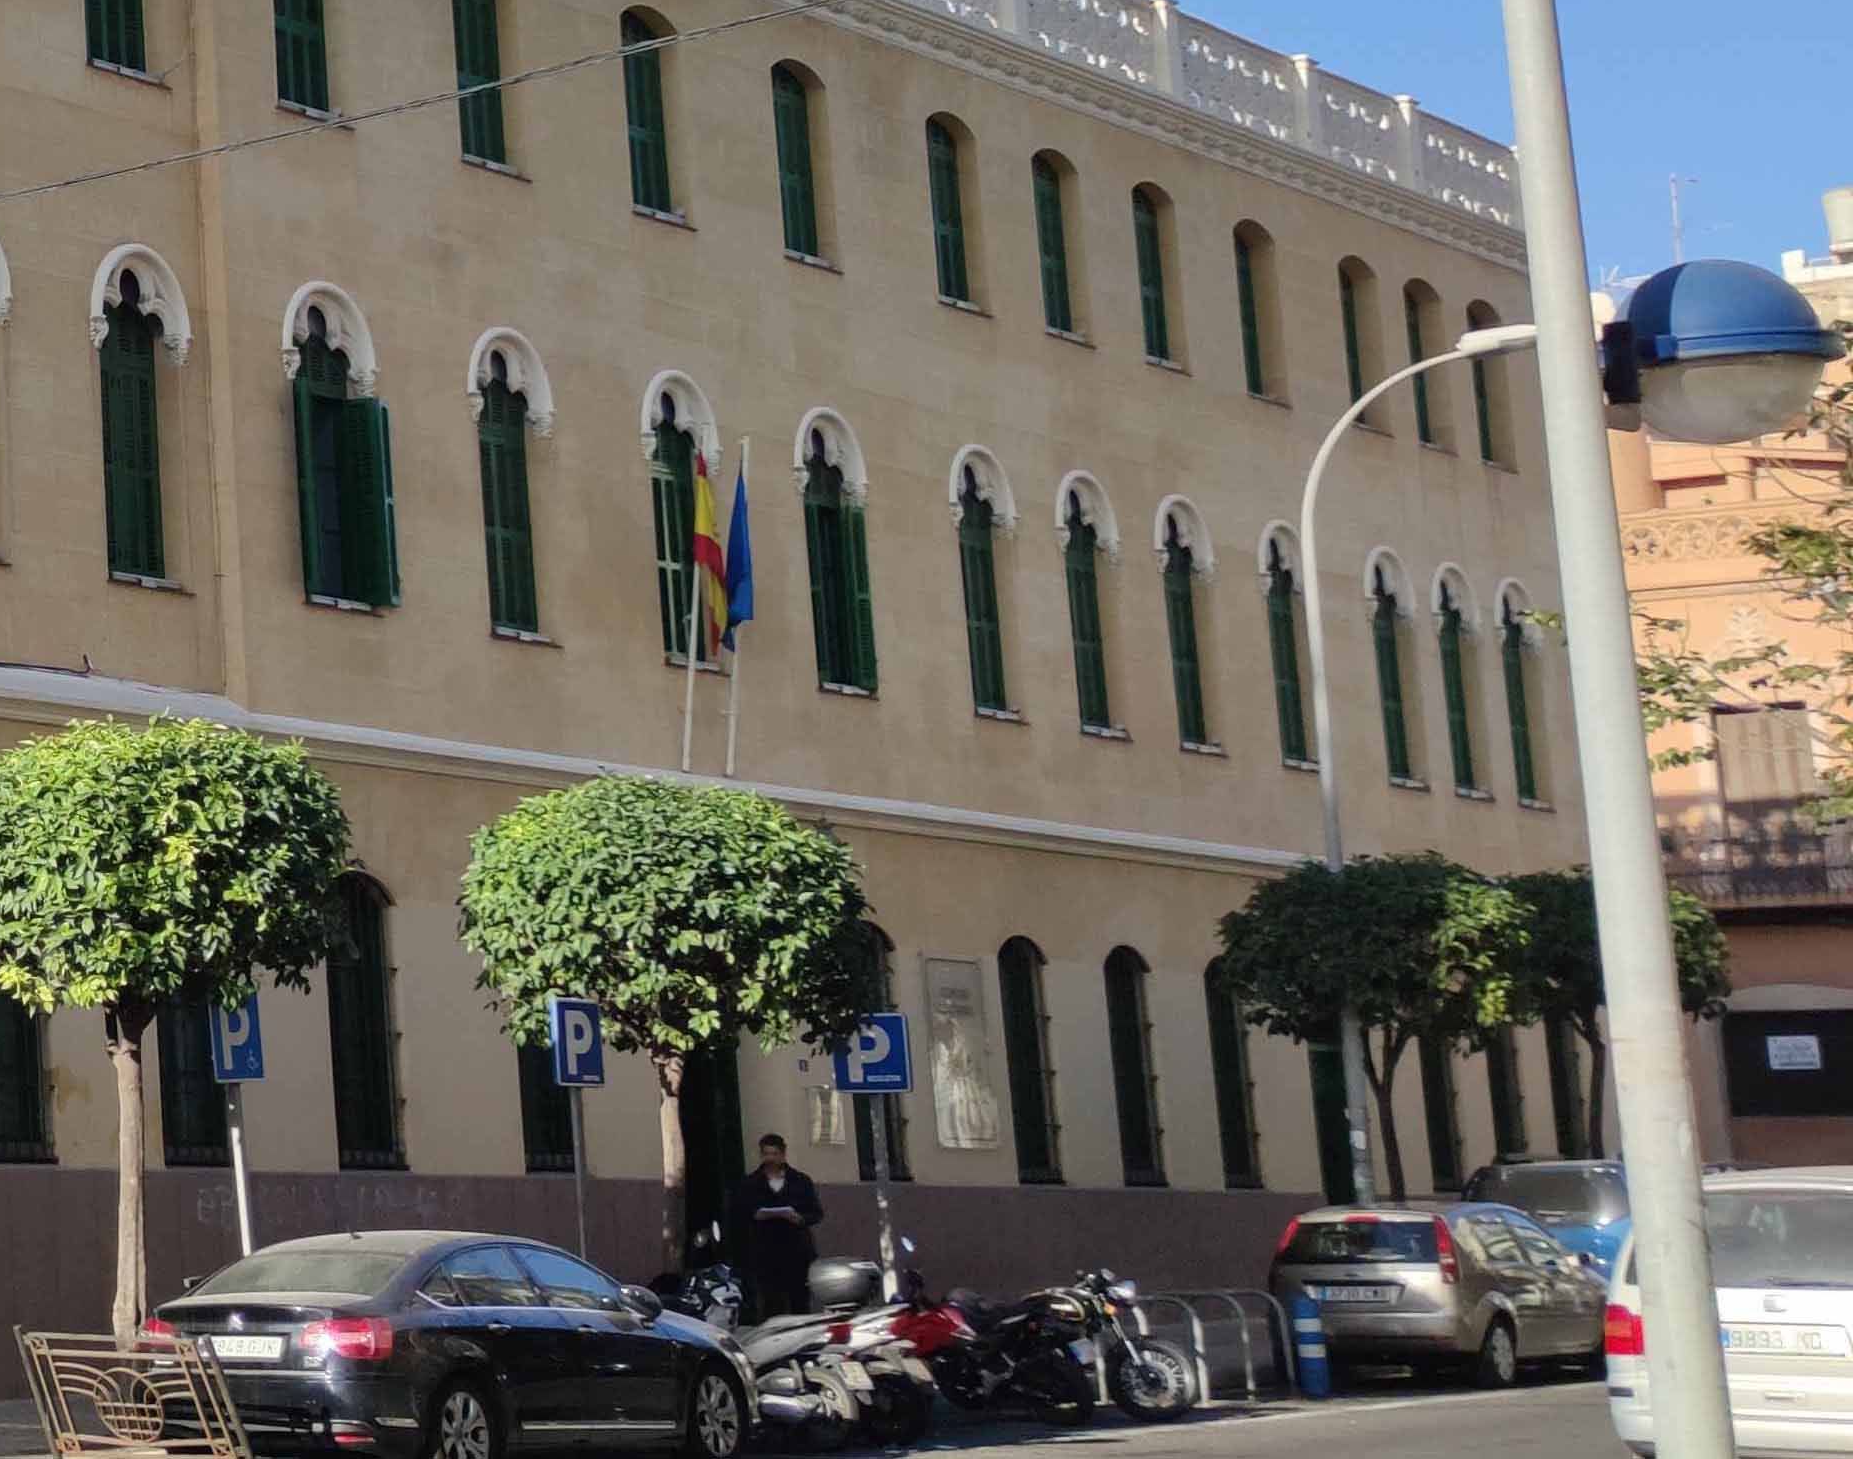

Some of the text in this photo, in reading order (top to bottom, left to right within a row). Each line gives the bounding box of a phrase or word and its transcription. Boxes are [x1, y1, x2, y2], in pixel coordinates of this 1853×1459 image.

[218, 1004, 250, 1071] P
[564, 1009, 593, 1075] P
[847, 1023, 891, 1083] P
